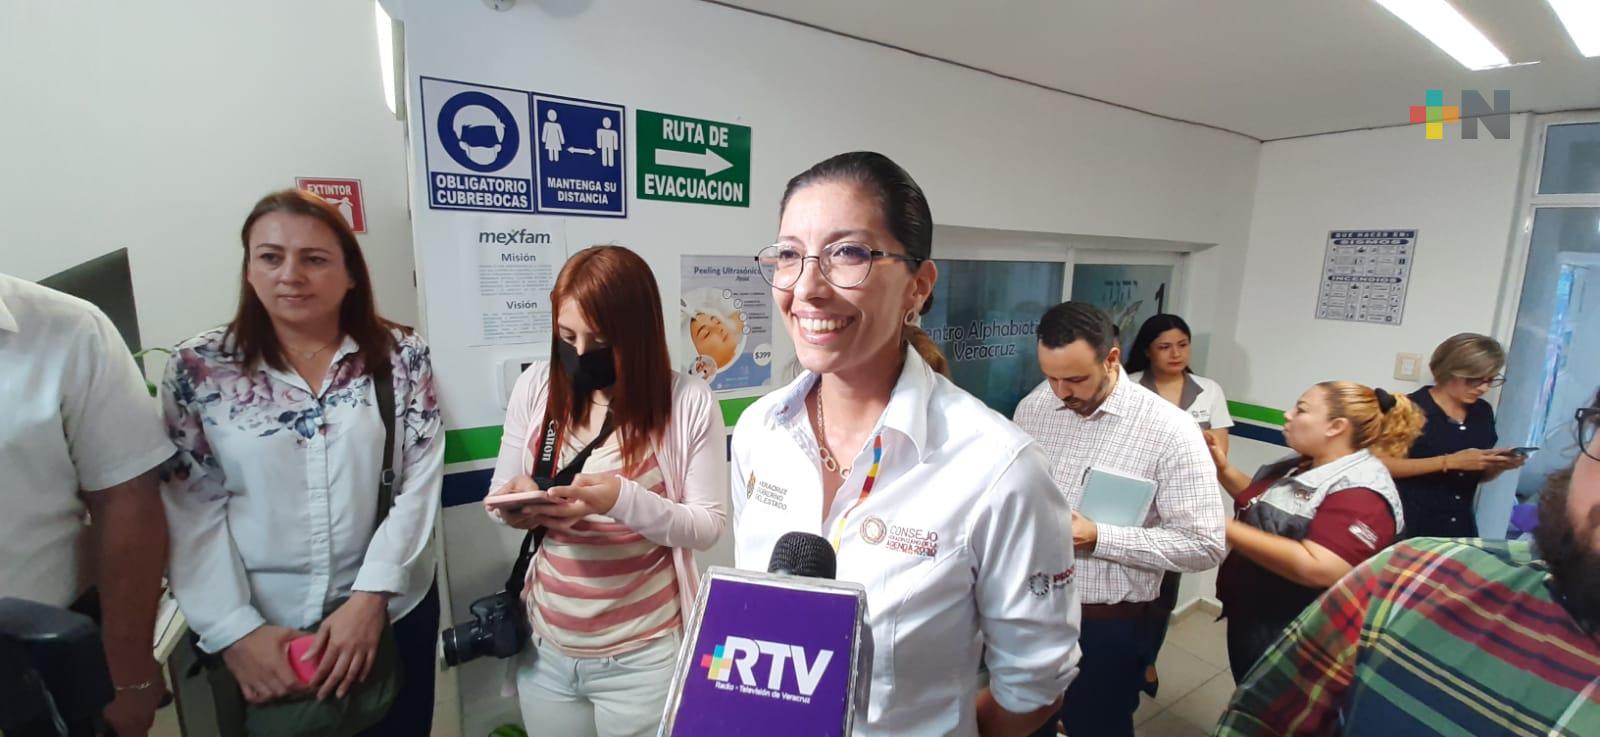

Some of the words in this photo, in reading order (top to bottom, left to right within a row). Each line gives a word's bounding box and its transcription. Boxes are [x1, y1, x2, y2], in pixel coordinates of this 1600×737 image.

[662, 118, 705, 145] RUTA
[709, 125, 728, 148] DE
[307, 184, 352, 196] EXTINTOR
[436, 174, 527, 194] OBLIGATORIO
[547, 177, 602, 192] MANTENGA
[604, 179, 617, 193] SU
[644, 173, 743, 202] EVACUACION
[436, 190, 529, 209] CUBREBOCAS
[557, 190, 609, 205] DISTANCIA
[479, 228, 551, 246] mexfam
[501, 253, 537, 262] Misión
[693, 266, 721, 276] Peeling
[506, 300, 538, 310] Visión
[925, 324, 964, 342] entro
[953, 341, 1016, 361] Veracruz
[542, 420, 556, 461] Canon
[889, 525, 938, 542] CONSEJO
[708, 635, 834, 696] RTV
[715, 680, 735, 691] Radio
[771, 688, 781, 699] de
[782, 692, 811, 704] Veracruz
